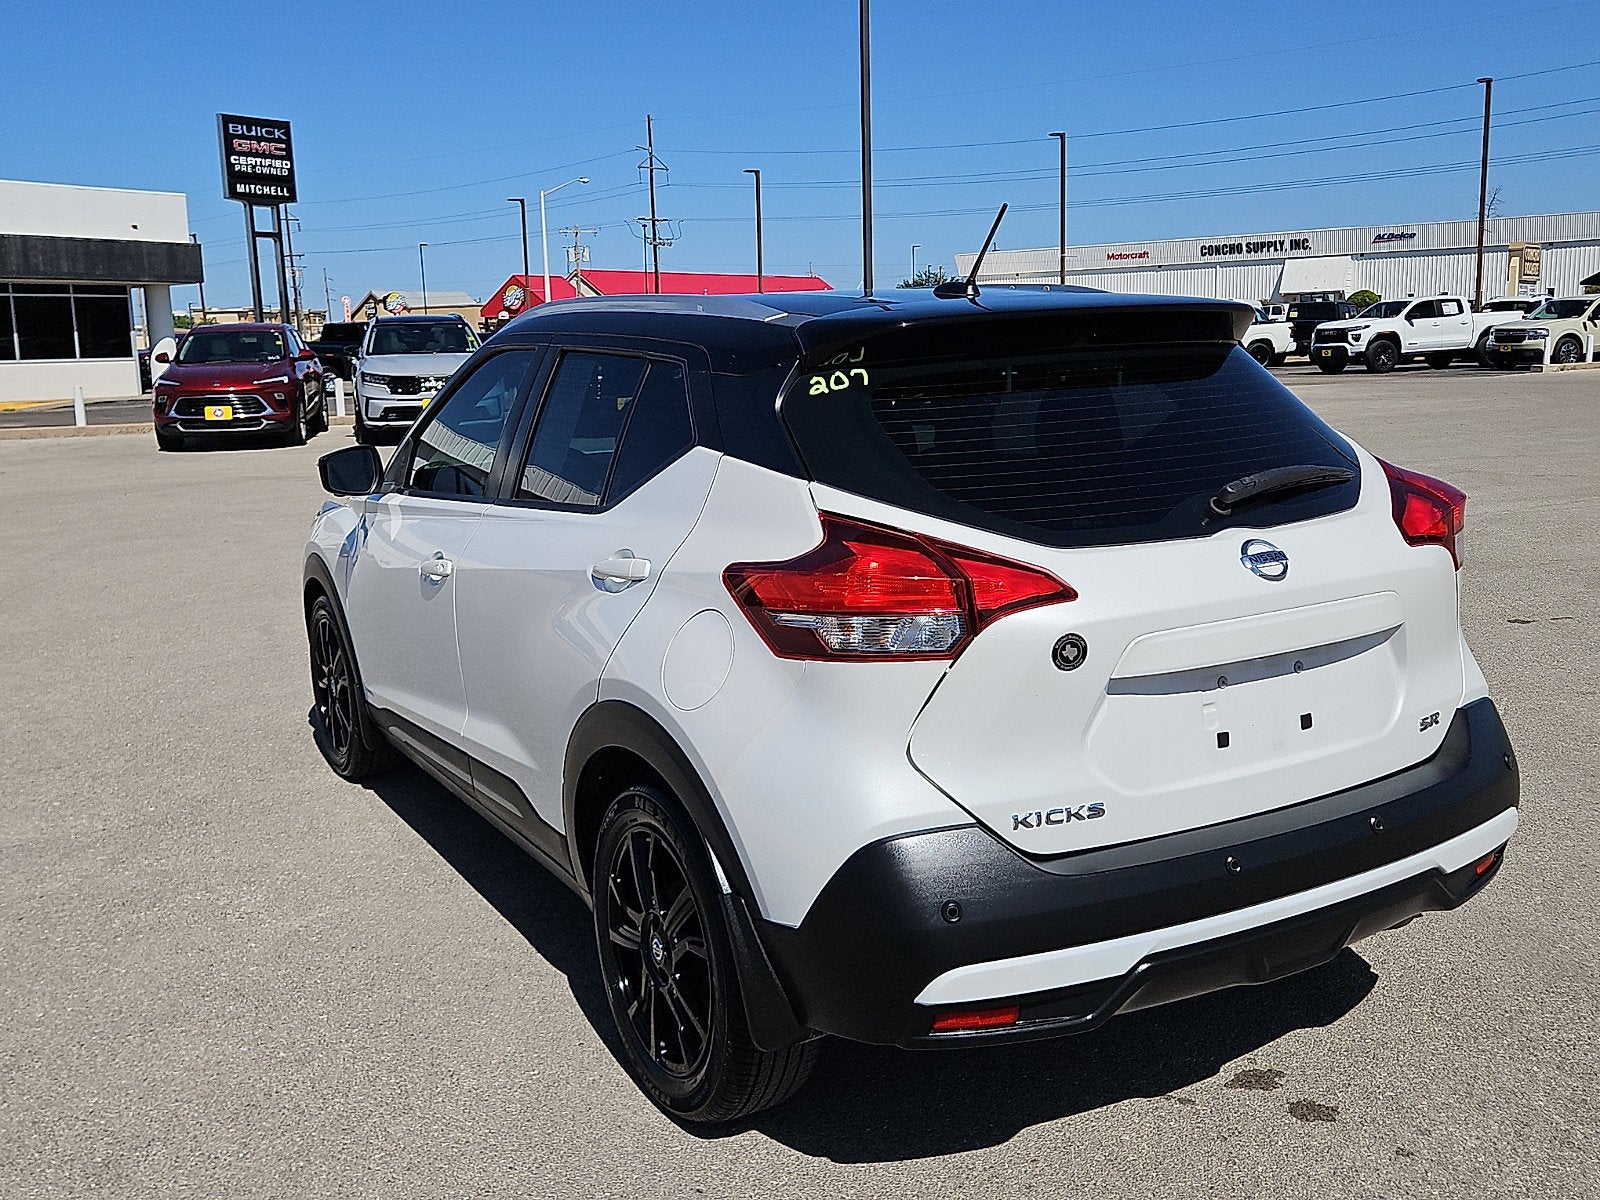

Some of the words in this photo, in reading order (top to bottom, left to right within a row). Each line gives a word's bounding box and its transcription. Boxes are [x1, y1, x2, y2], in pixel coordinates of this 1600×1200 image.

[228, 123, 287, 139] BUICK
[233, 139, 286, 156] GMC
[230, 155, 291, 168] CERTIFIED
[234, 165, 289, 175] PRE-OWNED
[236, 183, 289, 196] MITCHELL
[1107, 251, 1149, 260] Motorcraft
[1200, 243, 1243, 257] CONCHO
[1245, 240, 1288, 254] SUPPLY,
[1290, 238, 1312, 251] INC.
[809, 368, 869, 395] 207
[1419, 711, 1440, 733] SR
[1012, 802, 1106, 831] KICKS
